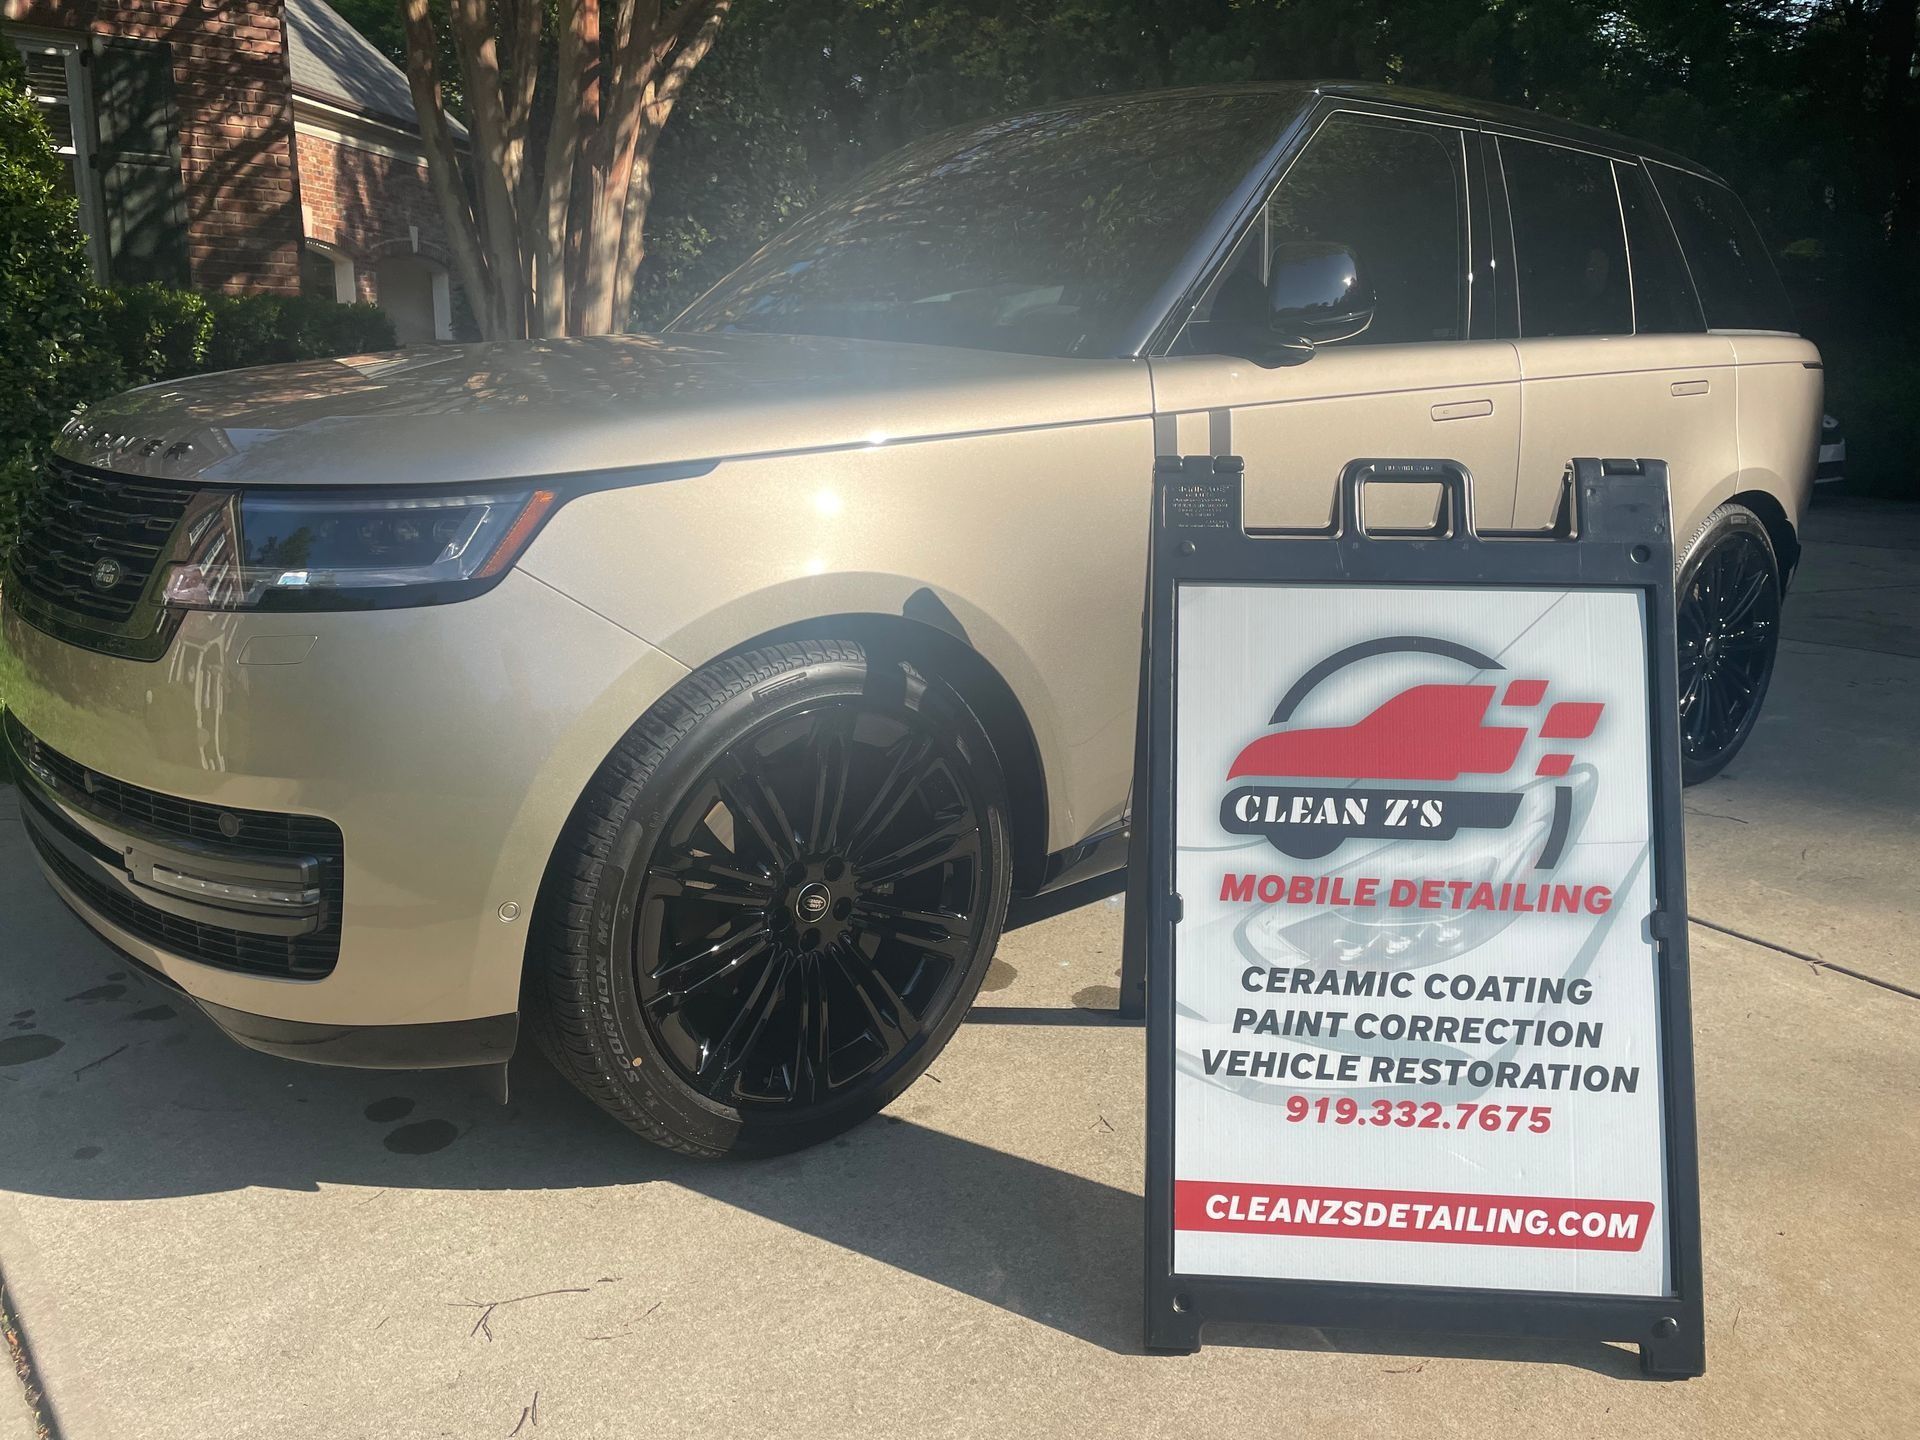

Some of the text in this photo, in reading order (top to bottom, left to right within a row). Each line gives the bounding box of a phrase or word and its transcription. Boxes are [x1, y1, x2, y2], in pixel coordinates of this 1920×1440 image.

[1236, 795, 1442, 827] CLEAN Z'S
[1219, 873, 1610, 914] MOBILE DETAILING
[1242, 967, 1592, 1004] CERAMIC COATING
[596, 955, 640, 1083] SCORPION
[1233, 1008, 1602, 1047] PAINT CORRECTION
[1202, 1049, 1639, 1092] VEHICLE RESTORATION
[1287, 1096, 1550, 1133] 919.332.7675
[1205, 1194, 1639, 1239] CLEANZSDETAILING.COM
